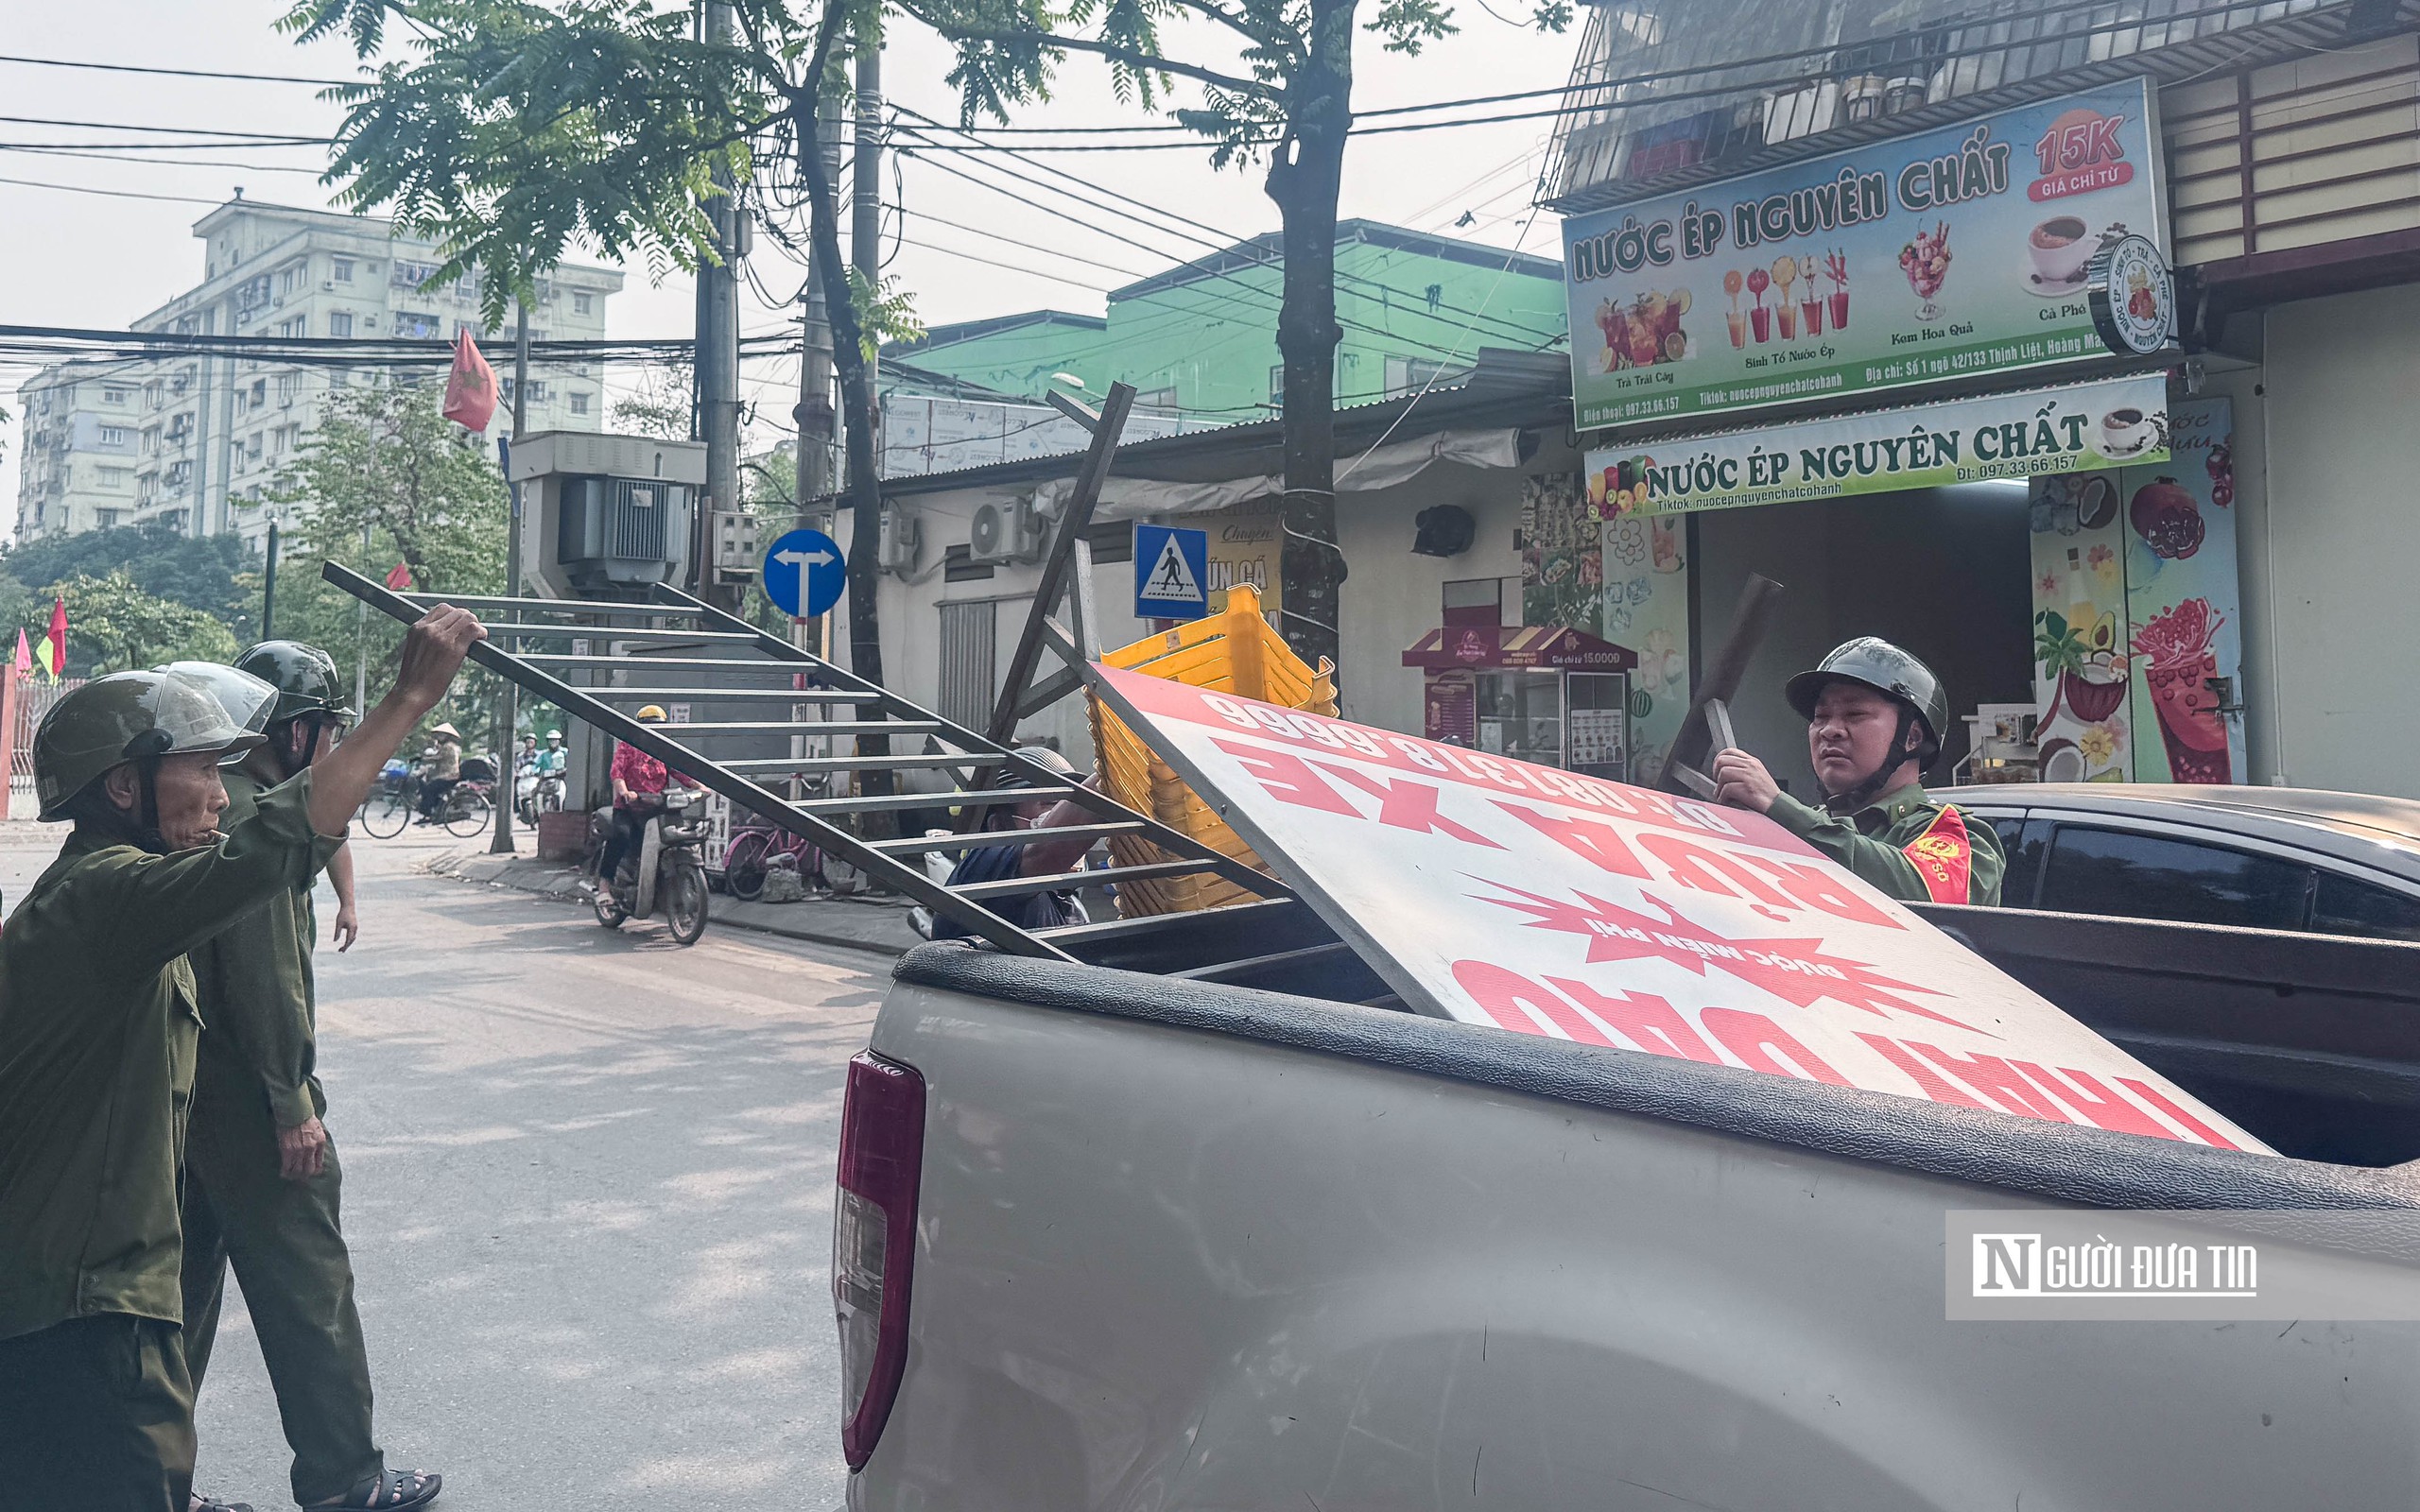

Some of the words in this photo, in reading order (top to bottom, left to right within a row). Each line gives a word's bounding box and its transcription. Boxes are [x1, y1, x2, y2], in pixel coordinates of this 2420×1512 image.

[2035, 114, 2125, 175] 15K
[2042, 177, 2066, 196] GIÁ
[1572, 215, 1674, 283] NƯỚC
[1680, 200, 1725, 259] ÉP
[1733, 165, 1888, 249] NGUYÊN
[1897, 124, 2011, 212] CHẤT
[2039, 307, 2057, 321] Cà
[1892, 333, 1918, 345] Kem
[1922, 328, 1945, 340] Hoa
[1949, 321, 1974, 336] Quả
[1745, 356, 1768, 368] Sinh
[1820, 342, 1835, 360] Ép
[1866, 368, 1882, 384] Địa
[1906, 356, 1919, 375] Số
[1922, 360, 1927, 374] 1
[1952, 350, 1986, 369] 42/133
[1989, 345, 2017, 366] Thịnh
[2048, 336, 2081, 357] Hoàng
[1616, 376, 1632, 388] Trà
[1626, 396, 1680, 417] 097.33.66.157
[1646, 453, 1738, 498] NƯỚC
[1747, 445, 1789, 488] ÉP
[1799, 425, 1961, 481] NGUYÊN
[1972, 400, 2088, 462] CHẤT
[1979, 455, 2078, 479] 097.33.66.157
[1656, 499, 1693, 511] Tiktok:
[1696, 483, 1841, 508] nuocepnguyenchatcohanh
[1200, 694, 1639, 815] 081318.6666
[1207, 736, 1512, 851] XE
[1485, 799, 1910, 931] RỬA
[1582, 918, 1652, 943] PHÍ
[1651, 931, 1746, 961] MIỄN
[1744, 949, 1850, 980] ĐƯỢC
